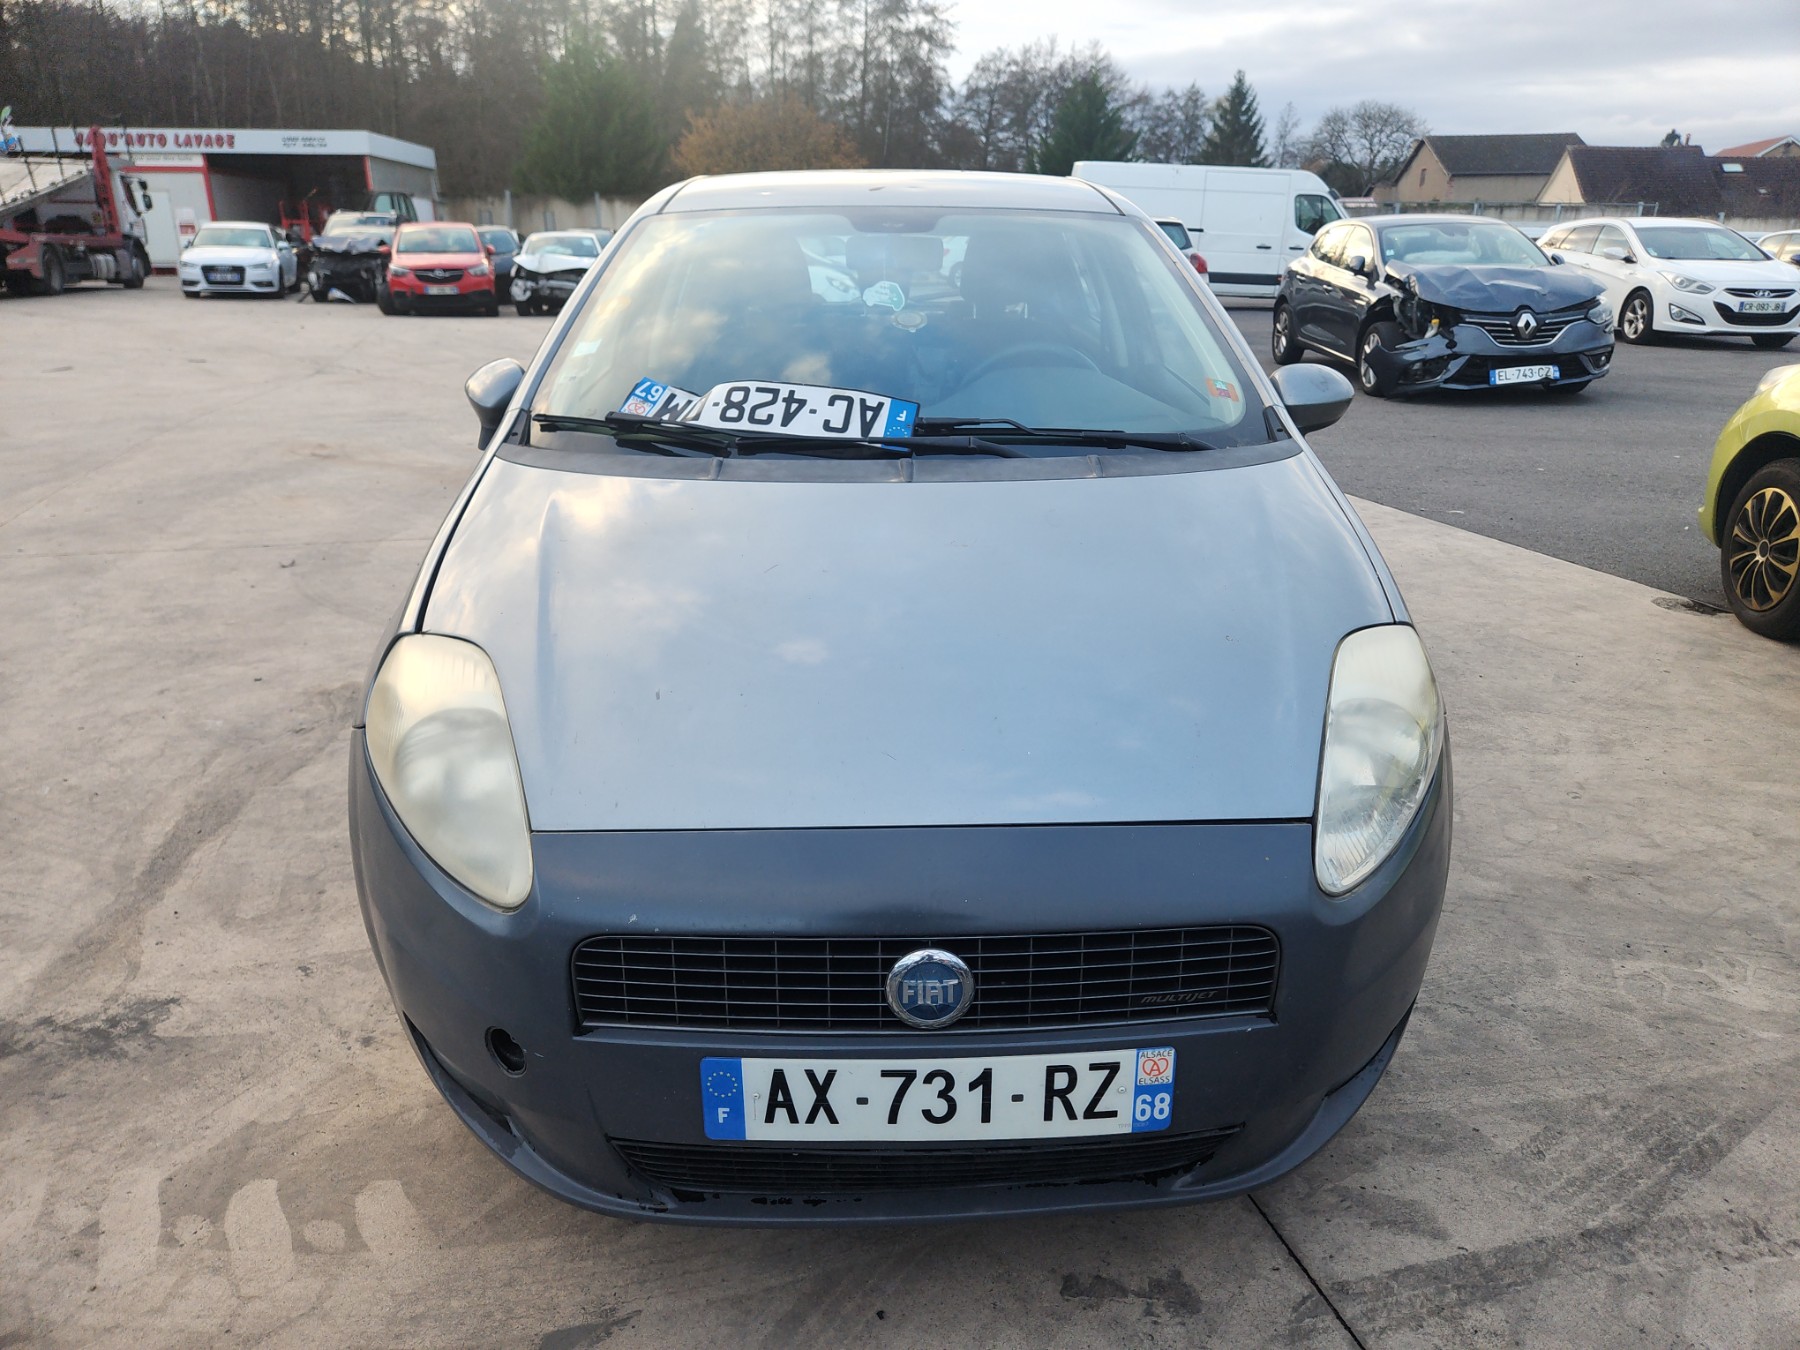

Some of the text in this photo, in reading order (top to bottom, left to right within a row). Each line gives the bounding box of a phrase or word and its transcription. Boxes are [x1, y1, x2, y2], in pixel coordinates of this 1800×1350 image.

[174, 133, 235, 149] LAVAGE
[1497, 366, 1552, 381] EL-743-CZ
[634, 381, 664, 402] 67
[896, 410, 907, 422] F
[902, 979, 959, 1005] FIAT
[1140, 1049, 1173, 1060] ALSACE
[1138, 1075, 1171, 1085] ELSASS
[1135, 1092, 1171, 1122] 68
[717, 1107, 730, 1124] F
